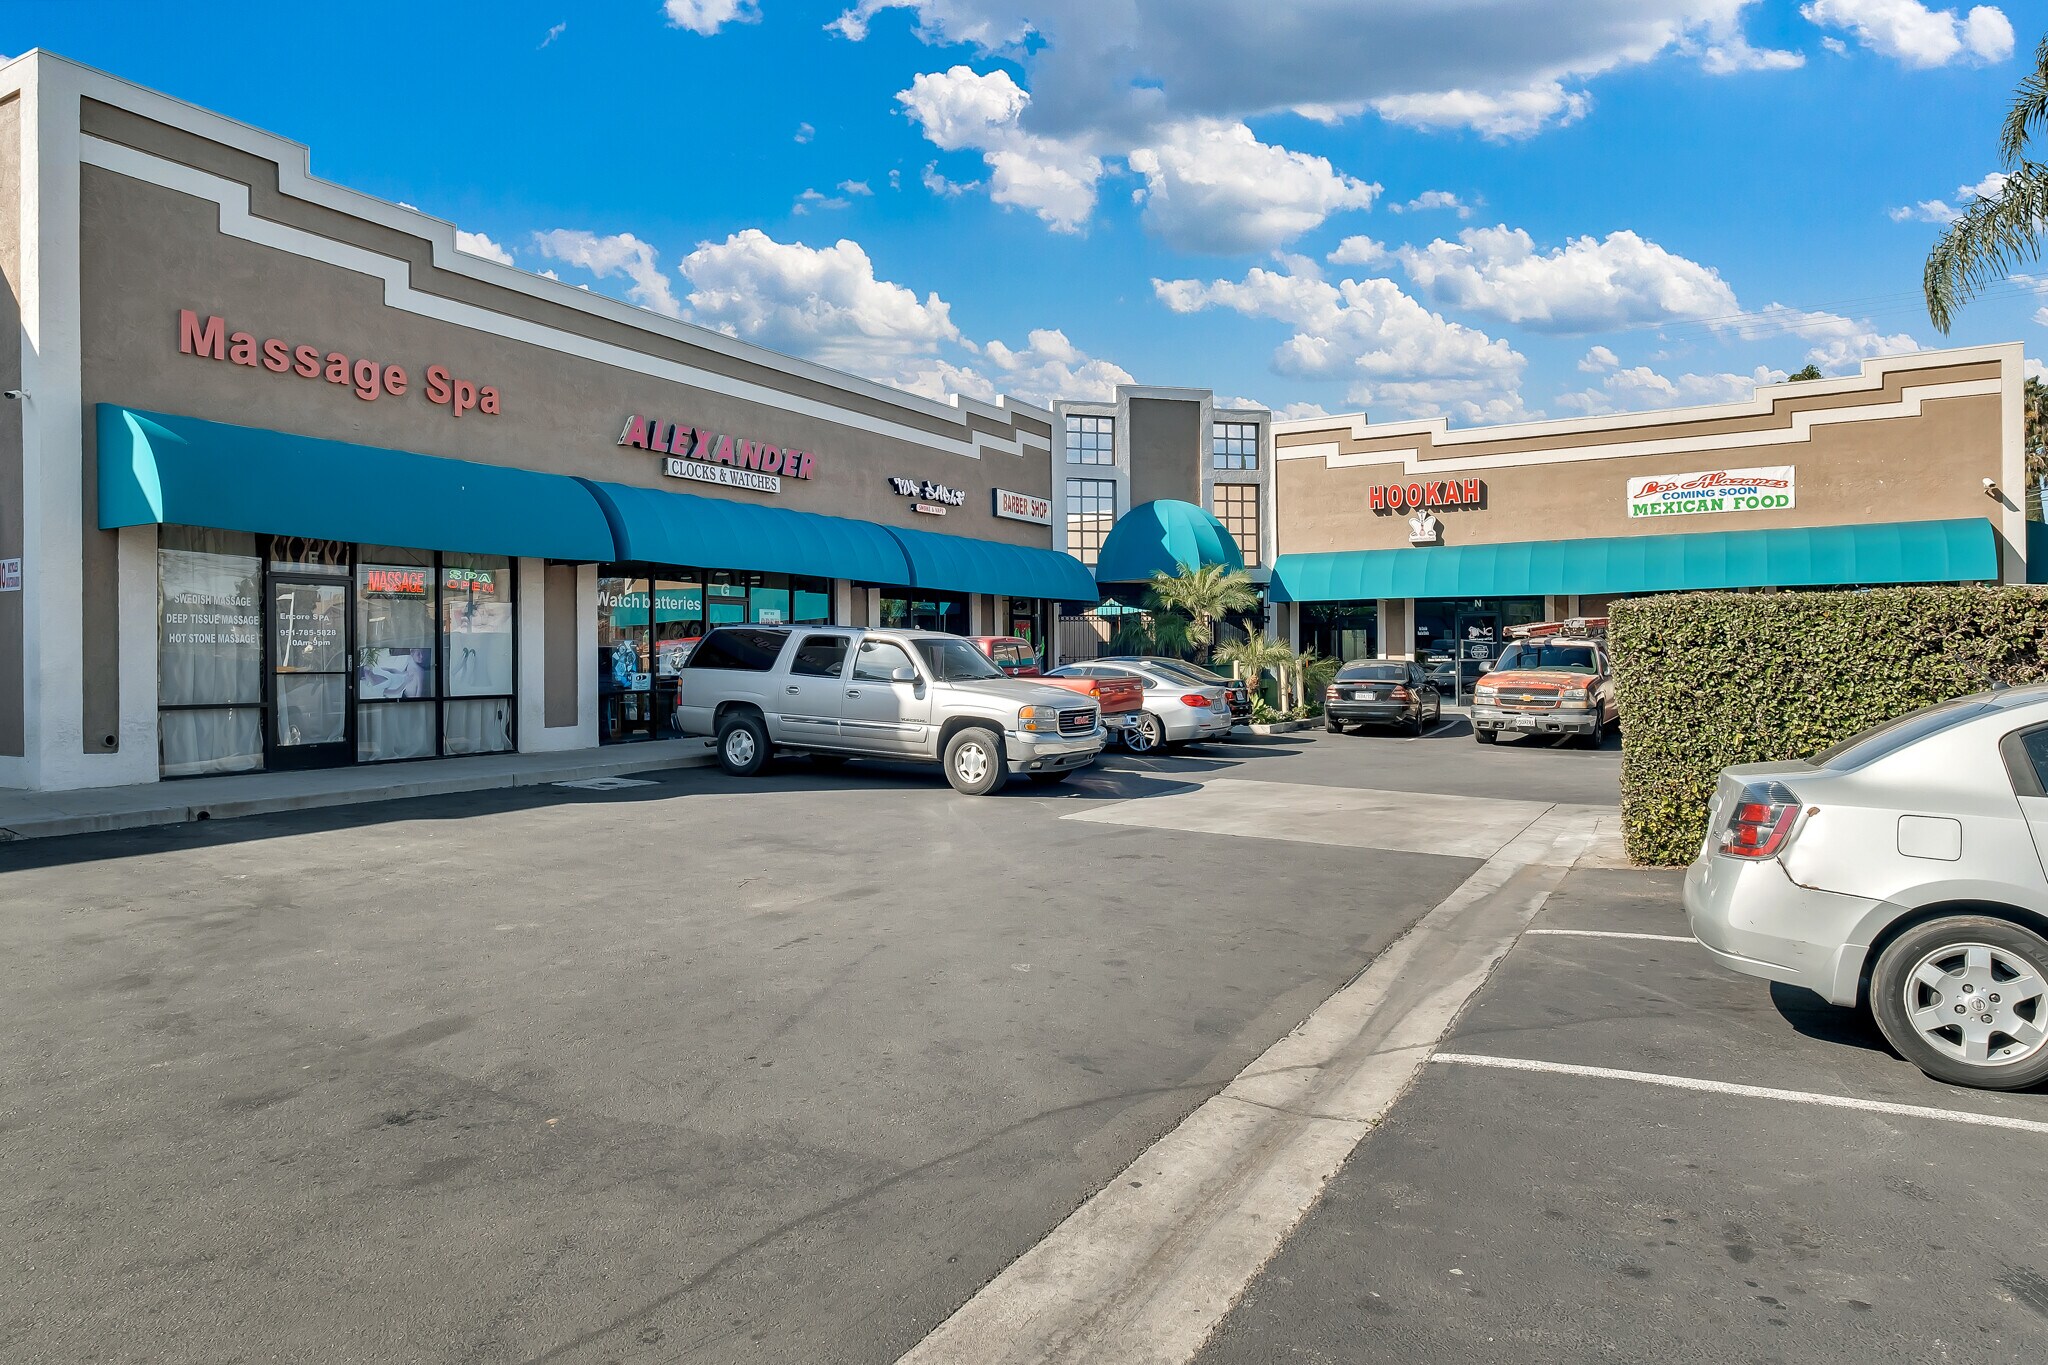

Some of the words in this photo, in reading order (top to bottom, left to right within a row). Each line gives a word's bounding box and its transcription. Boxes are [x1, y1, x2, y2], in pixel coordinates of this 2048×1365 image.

[178, 309, 408, 401] Massage
[424, 364, 501, 417] Spa
[617, 415, 816, 480] ALEXANDER
[671, 460, 717, 481] CLOCKS
[719, 468, 728, 483] &
[730, 470, 777, 491] WATCHES
[893, 477, 920, 497] TOP
[1368, 478, 1480, 509] HOOKAH
[1633, 481, 1679, 498] Los
[1662, 489, 1715, 501] COMING
[1719, 486, 1758, 496] SOON
[1003, 493, 1028, 515] BARBER
[1031, 500, 1047, 519] SHOP
[1632, 498, 1723, 517] MEXICAN
[1734, 495, 1789, 509] FOOD
[368, 570, 425, 593] MASSAGE
[449, 569, 492, 584] SPA
[447, 580, 495, 593] OPEN
[720, 583, 730, 597] G
[174, 593, 211, 605] SWEDISH
[213, 595, 251, 607] MASSAGE
[598, 591, 640, 609] Watch
[642, 593, 701, 611] batteries
[1474, 599, 1482, 608] N
[166, 613, 188, 624] DEEP
[190, 614, 220, 625] TISSUE
[221, 614, 259, 625] MASSAGE
[280, 612, 310, 620] Encore
[312, 612, 330, 622] SPA
[169, 633, 187, 643] HOT
[188, 633, 216, 643] STONE
[217, 633, 256, 644] MASSAGE
[280, 629, 337, 637] 951-785-5828
[1074, 715, 1090, 725] GMC
